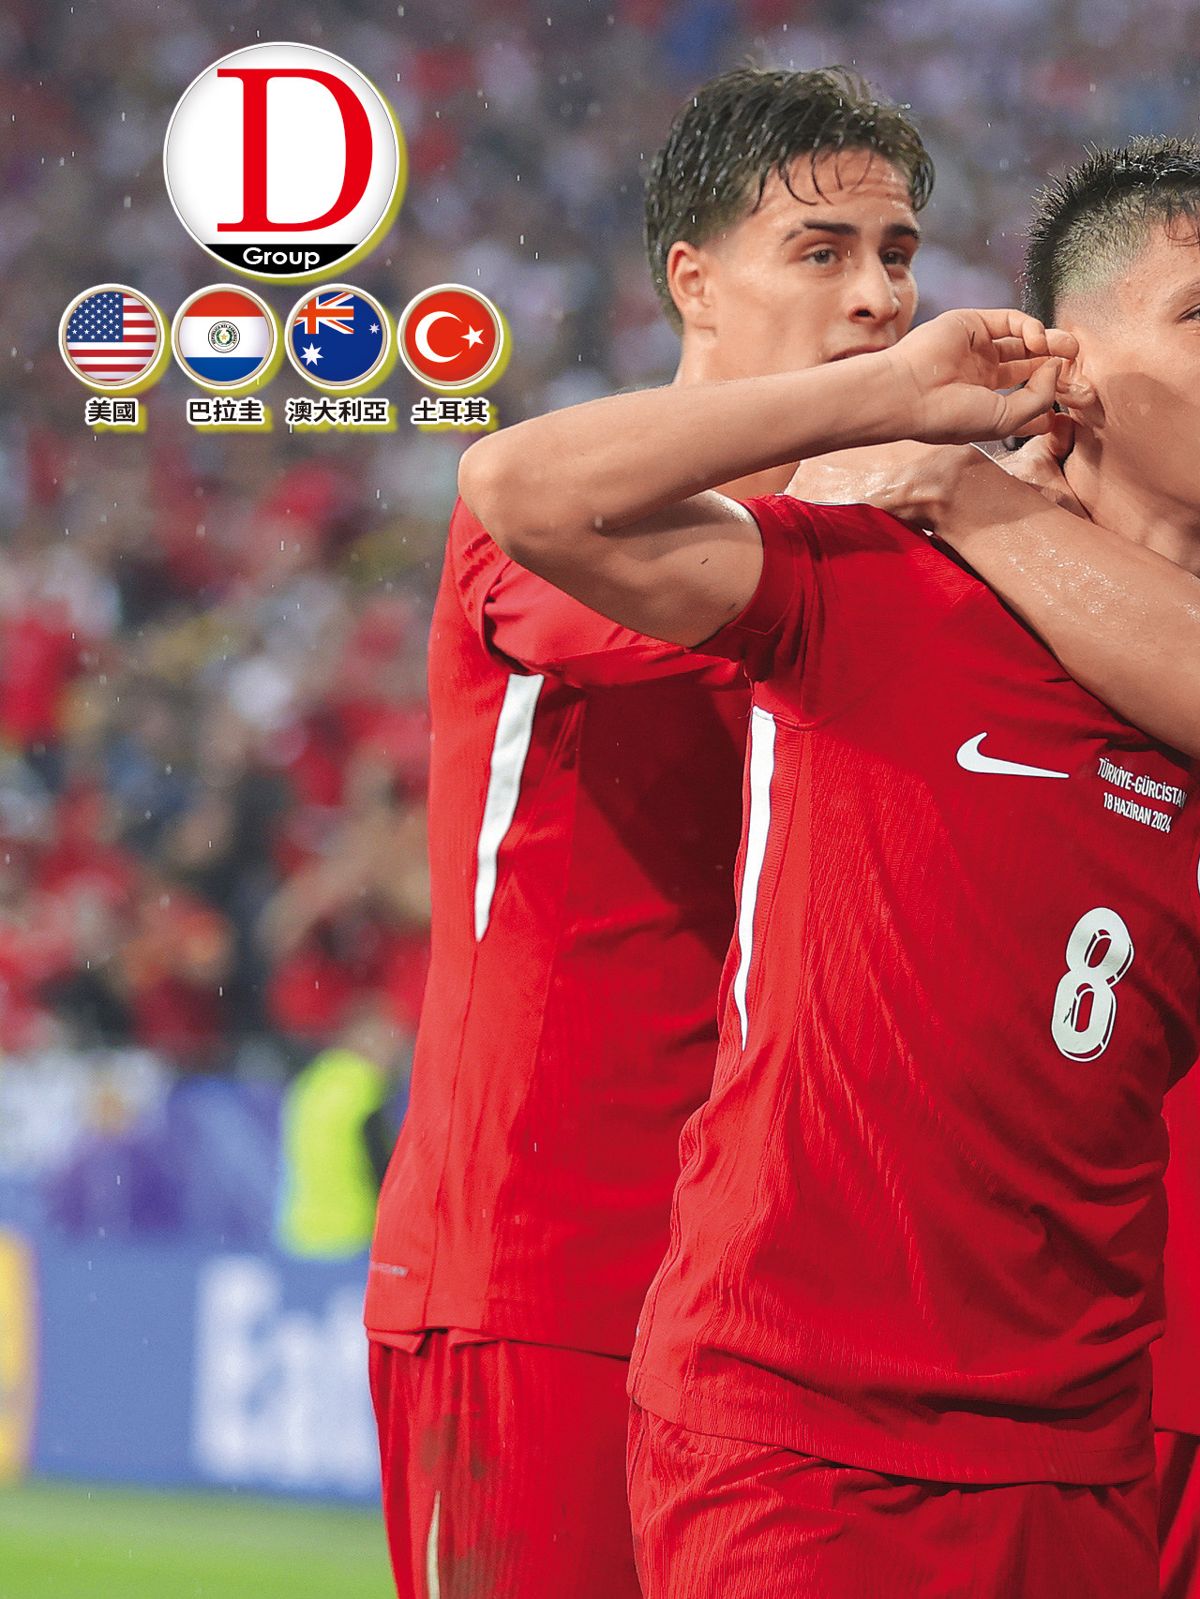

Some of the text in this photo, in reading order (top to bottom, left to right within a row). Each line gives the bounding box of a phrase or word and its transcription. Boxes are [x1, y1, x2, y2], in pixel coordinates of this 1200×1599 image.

[1103, 792, 1173, 834] 18 HAZİRAN 2024
[1050, 906, 1135, 1063] 8
